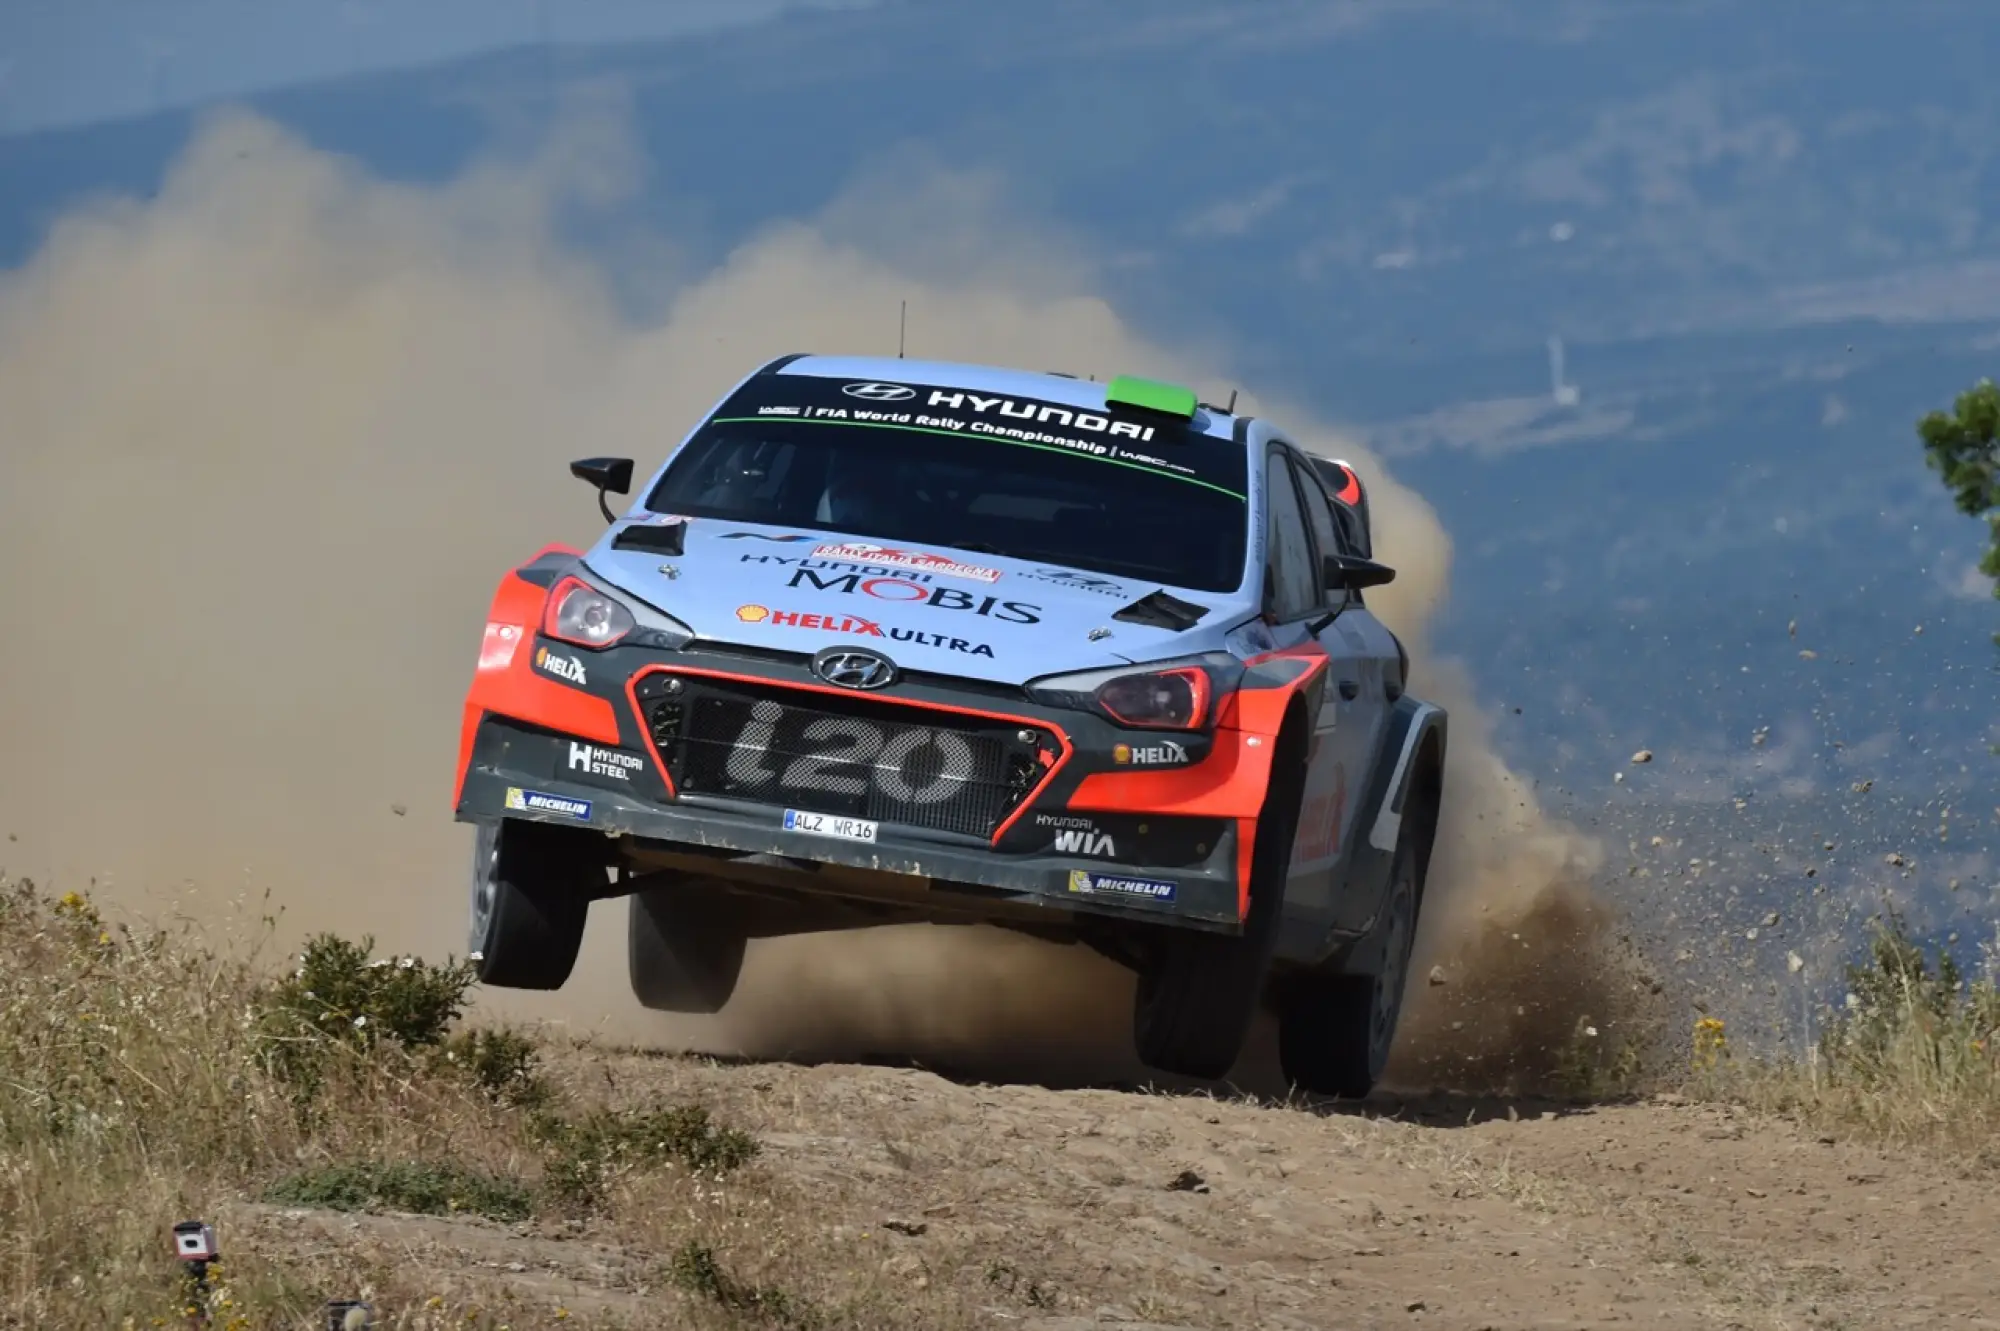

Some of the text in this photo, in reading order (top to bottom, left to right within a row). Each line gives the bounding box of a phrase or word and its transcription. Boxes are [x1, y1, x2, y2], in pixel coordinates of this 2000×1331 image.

[815, 407, 848, 418] FIA
[854, 410, 911, 423] World
[915, 415, 965, 431] Rally
[970, 421, 1107, 455] Championship
[927, 391, 1155, 442] HYUNDAI
[740, 554, 933, 583] HYUNDAI
[820, 545, 995, 577] RALLY ITALIA SARDEGNA
[785, 568, 1043, 625] MOBIS
[1017, 572, 1128, 599] HYUNDAI
[771, 610, 995, 658] HELIX ULTRA
[544, 653, 587, 685] HELIX
[593, 749, 643, 771] HYUNDAI
[726, 700, 975, 804] i20
[1131, 740, 1189, 764] HELIX
[592, 763, 630, 780] STEEL
[528, 796, 588, 815] MICHELIN
[795, 814, 823, 832] ALZ
[1036, 814, 1093, 829] HYUNDAI
[1055, 828, 1116, 857] WIA
[1096, 877, 1172, 896] MICHELIN
